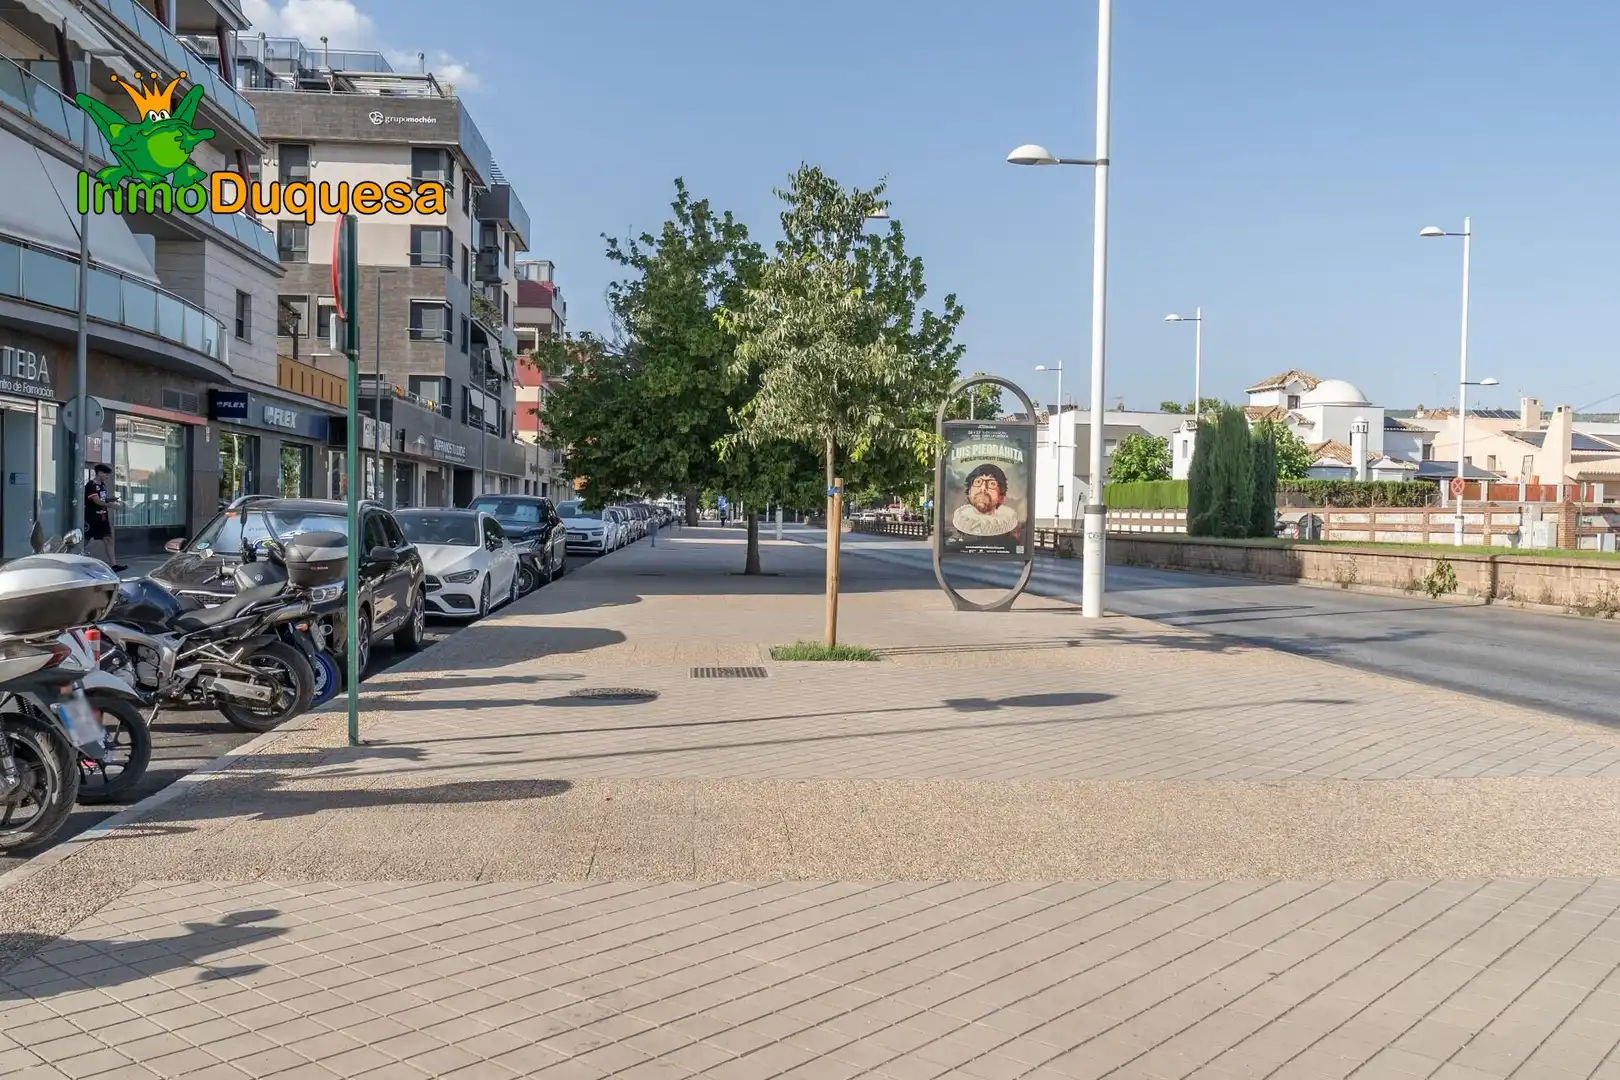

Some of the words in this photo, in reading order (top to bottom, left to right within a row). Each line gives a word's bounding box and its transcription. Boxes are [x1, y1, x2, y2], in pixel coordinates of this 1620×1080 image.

[385, 114, 437, 125] grupomochón
[13, 380, 22, 392] de
[22, 382, 54, 398] Formación
[274, 407, 297, 428] FLEX
[951, 446, 971, 461] LUIS
